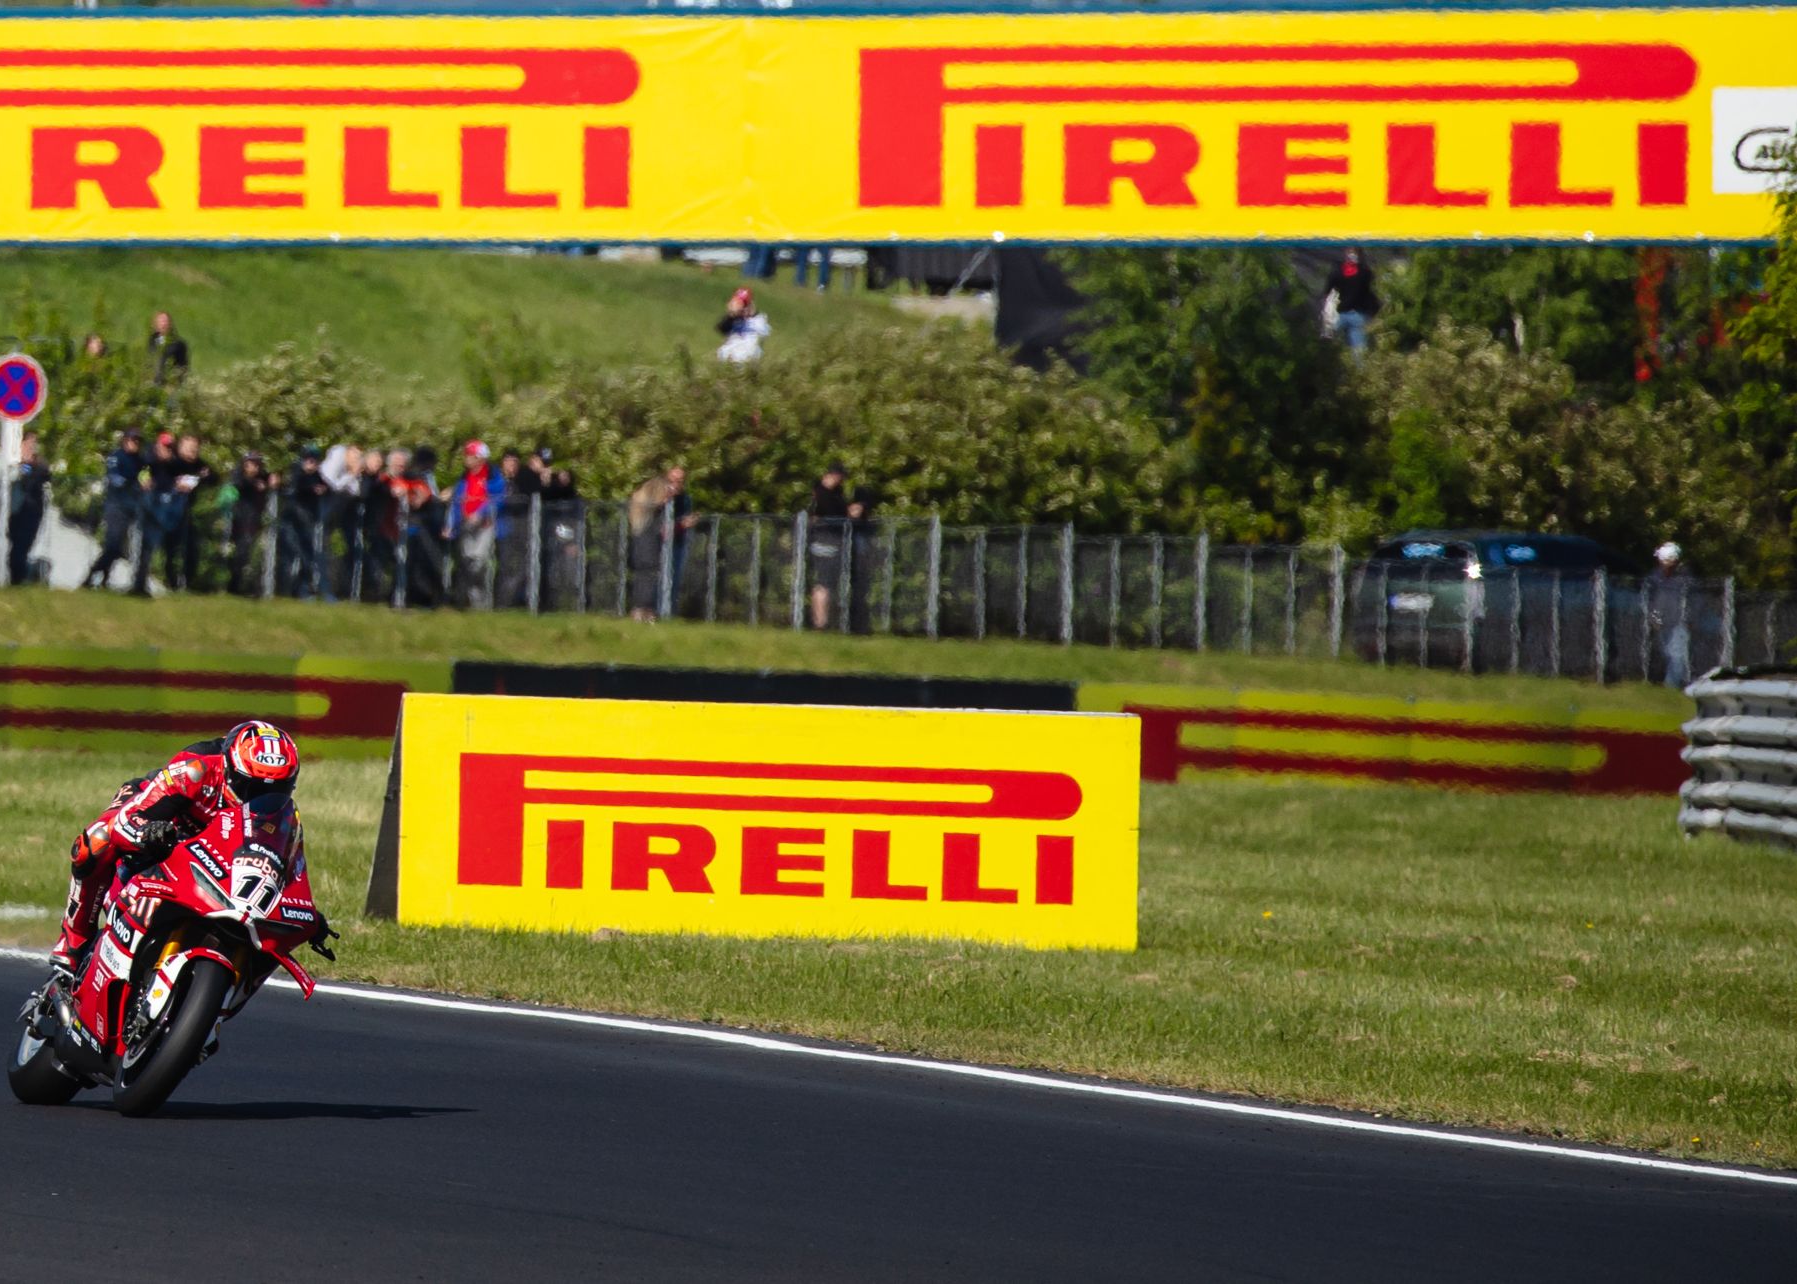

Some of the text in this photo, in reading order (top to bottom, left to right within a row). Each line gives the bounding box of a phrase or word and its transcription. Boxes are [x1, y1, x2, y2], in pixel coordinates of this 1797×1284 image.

[858, 43, 1698, 208] PIRELLI
[256, 755, 287, 767] KYT
[457, 752, 1083, 905] PIRELLI
[189, 843, 224, 878] Lenovo
[236, 874, 280, 914] 11
[281, 897, 313, 907] ALTEN
[282, 906, 314, 921] Lenovo
